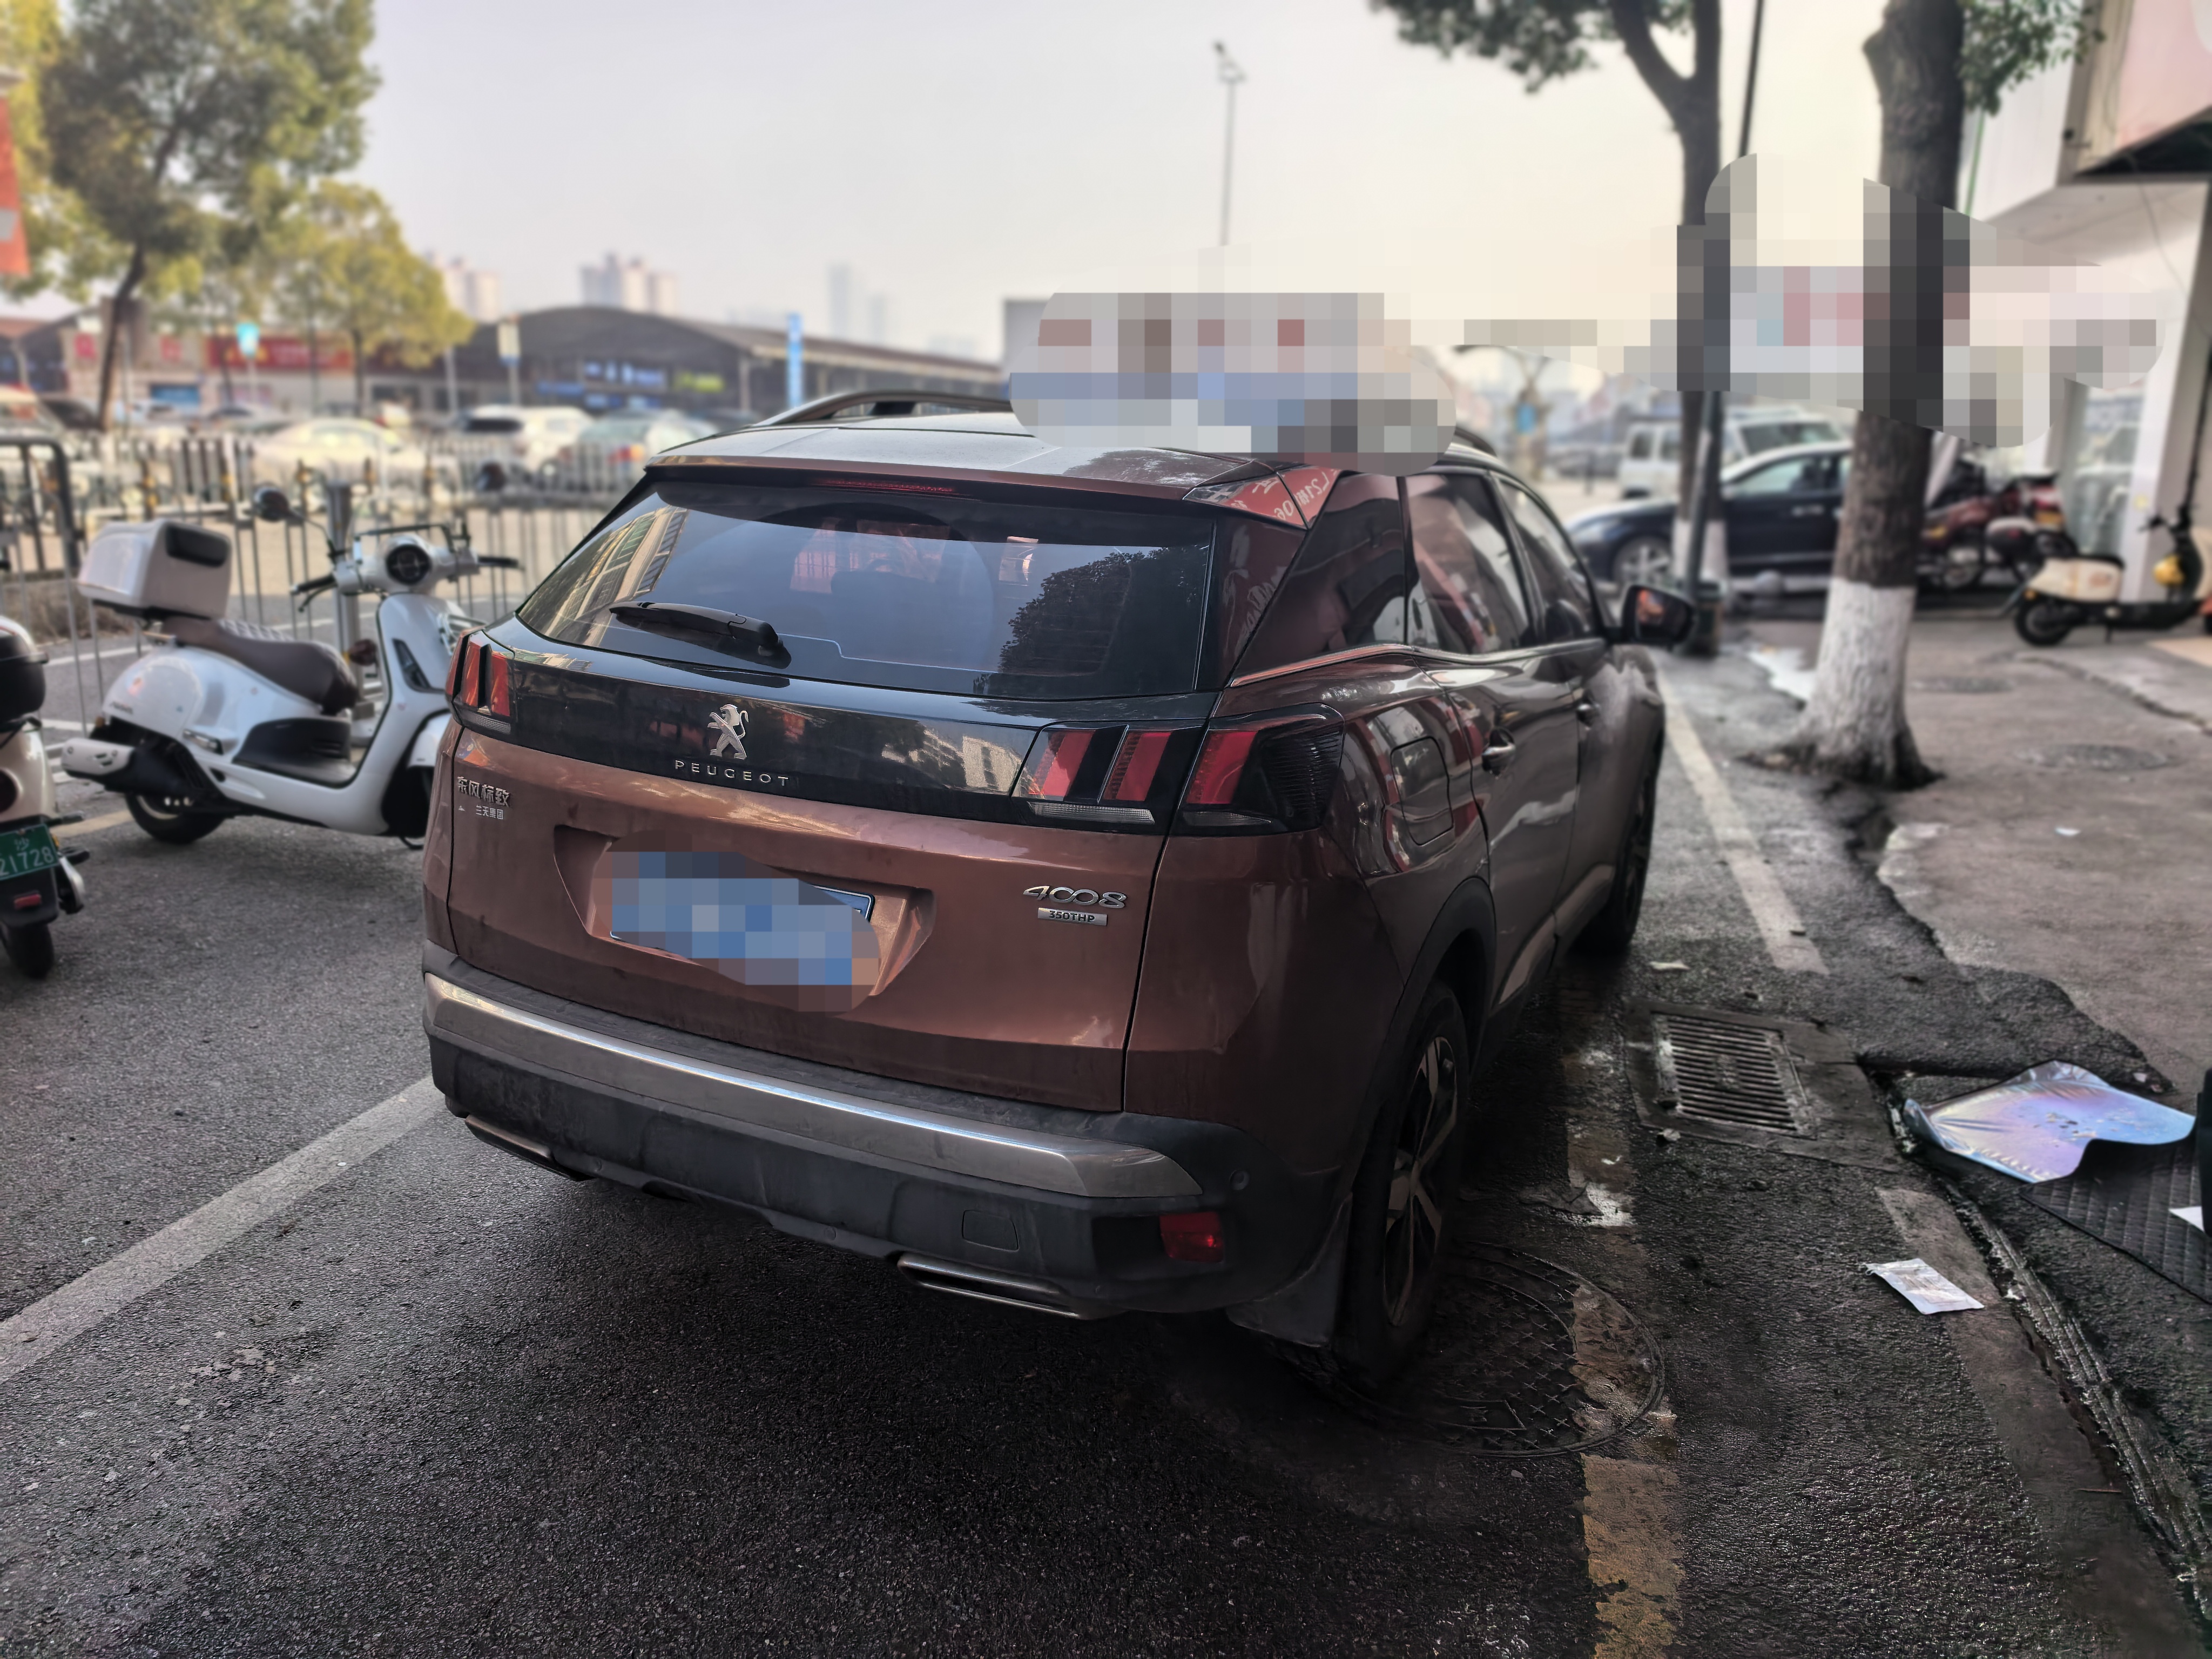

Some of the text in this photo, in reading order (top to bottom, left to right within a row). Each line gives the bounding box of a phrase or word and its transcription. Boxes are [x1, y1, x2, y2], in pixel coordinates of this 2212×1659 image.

[675, 760, 789, 786] PEUGEOT
[457, 777, 510, 807] 东风标致
[475, 805, 503, 820] 兰天集团
[0, 846, 54, 875] 21728
[1023, 885, 1127, 909] 4008
[1049, 910, 1096, 922] 350THP
